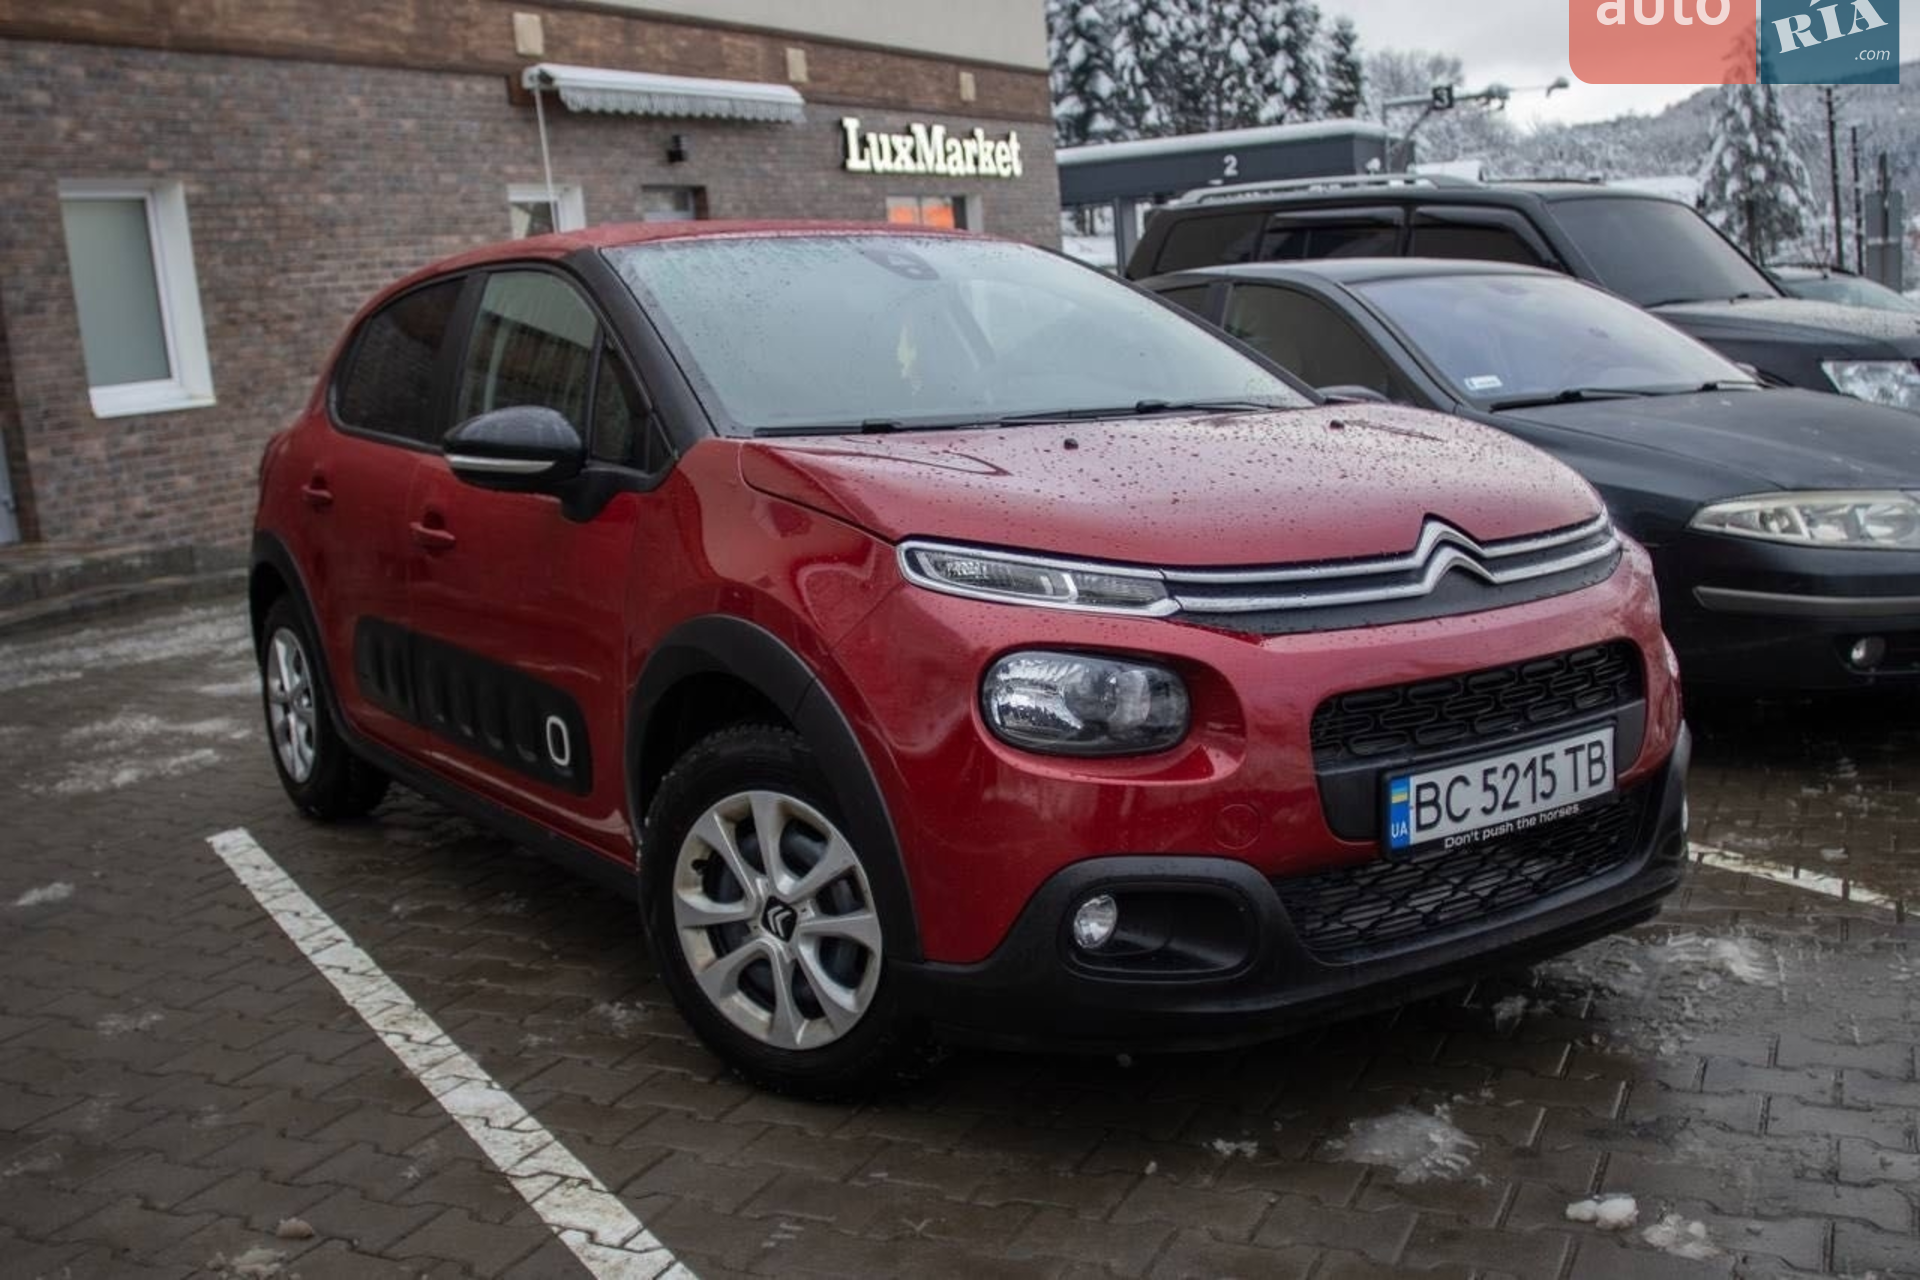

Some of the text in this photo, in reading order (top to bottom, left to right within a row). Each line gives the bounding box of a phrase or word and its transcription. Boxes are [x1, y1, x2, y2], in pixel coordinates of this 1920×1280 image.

[842, 117, 1023, 177] LuxMarket
[1223, 154, 1238, 176] 2
[1415, 739, 1607, 833] BC 5215 TB
[1391, 821, 1408, 839] UA
[1444, 803, 1580, 849] Don't push the horses
